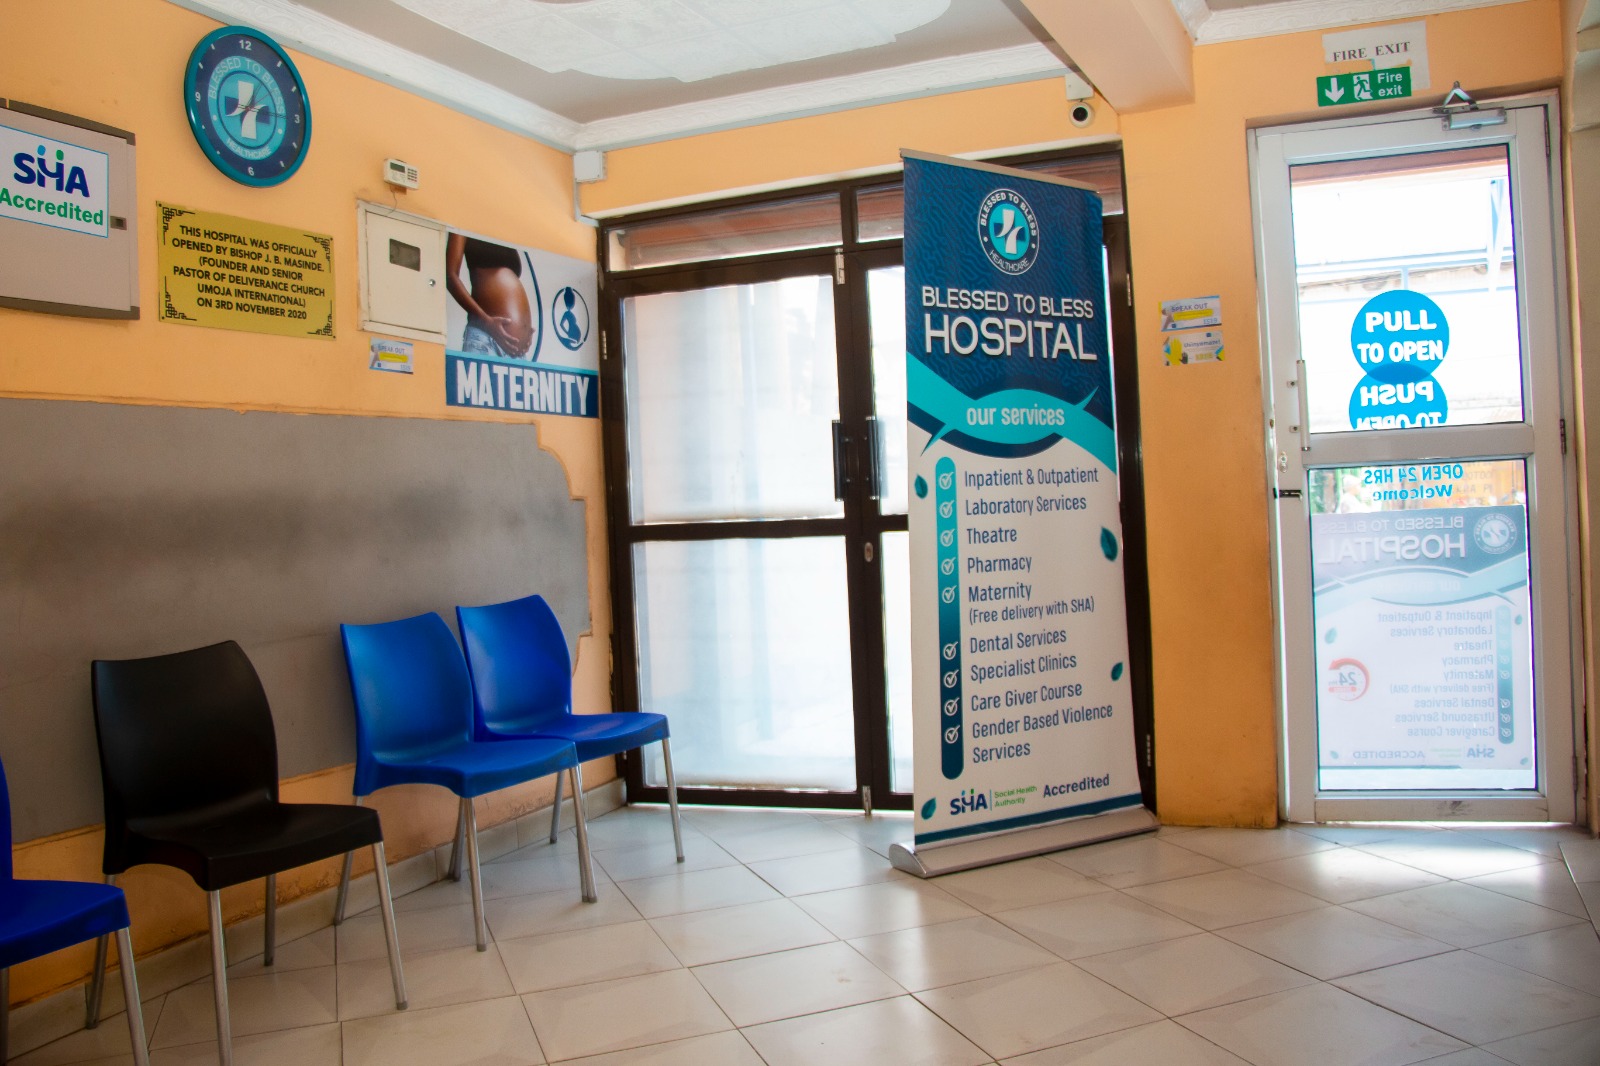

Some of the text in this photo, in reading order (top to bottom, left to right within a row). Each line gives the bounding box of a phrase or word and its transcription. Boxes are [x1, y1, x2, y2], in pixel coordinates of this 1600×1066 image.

[239, 39, 252, 51] 12
[1333, 41, 1410, 62] FIRE EXIT
[208, 57, 285, 114] BLESSED TO BLESS
[1377, 72, 1403, 84] Fire
[1378, 84, 1403, 97] exit
[195, 92, 201, 102] 9
[294, 114, 300, 124] 3
[226, 137, 272, 159] HEALTHCARE
[13, 145, 90, 198] SHA
[248, 166, 254, 176] 6
[0, 187, 104, 226] Accredited
[980, 192, 1006, 227] BLESSED
[1008, 193, 1020, 204] TO
[172, 237, 324, 272] OPENED BY BISHOP J. B. MASINDE.
[180, 225, 317, 259] THIS HOSPITAL WAS OFFICIALLY
[199, 256, 303, 282] (FOUNDER AND SENIOR
[989, 249, 1030, 272] HEALTHCARE
[173, 266, 325, 297] PASTOR OF DELIVERANCE CHURCH
[197, 283, 306, 308] UMOJA INTERNATIONAL)
[922, 286, 1094, 319] BLESSED TO BLESS
[197, 297, 307, 320] ON 3RD NOVEMBER 2020
[1171, 304, 1193, 313] SPEAK
[1365, 309, 1437, 333] PULL
[924, 313, 1098, 361] HOSPITAL
[1357, 339, 1444, 364] TO OPEN
[456, 360, 589, 415] MATERNITY
[966, 403, 1065, 426] our services
[964, 467, 1099, 491] Inpatient & Outpatient
[965, 496, 1087, 516] Laboratory Services
[966, 528, 1018, 545] Theatre
[967, 556, 1032, 574] Pharmacy
[968, 582, 1032, 602] Maternity
[969, 596, 1095, 626] (Free delivery with SHA)
[970, 629, 1067, 654] Dental Services
[970, 653, 1077, 684] Specialist Clinics
[971, 683, 1083, 712] Care Giver Course
[972, 704, 1113, 739] Gender Based Violence
[973, 742, 1031, 764] Services
[1043, 774, 1110, 799] Accredited
[950, 789, 988, 816] SHA
